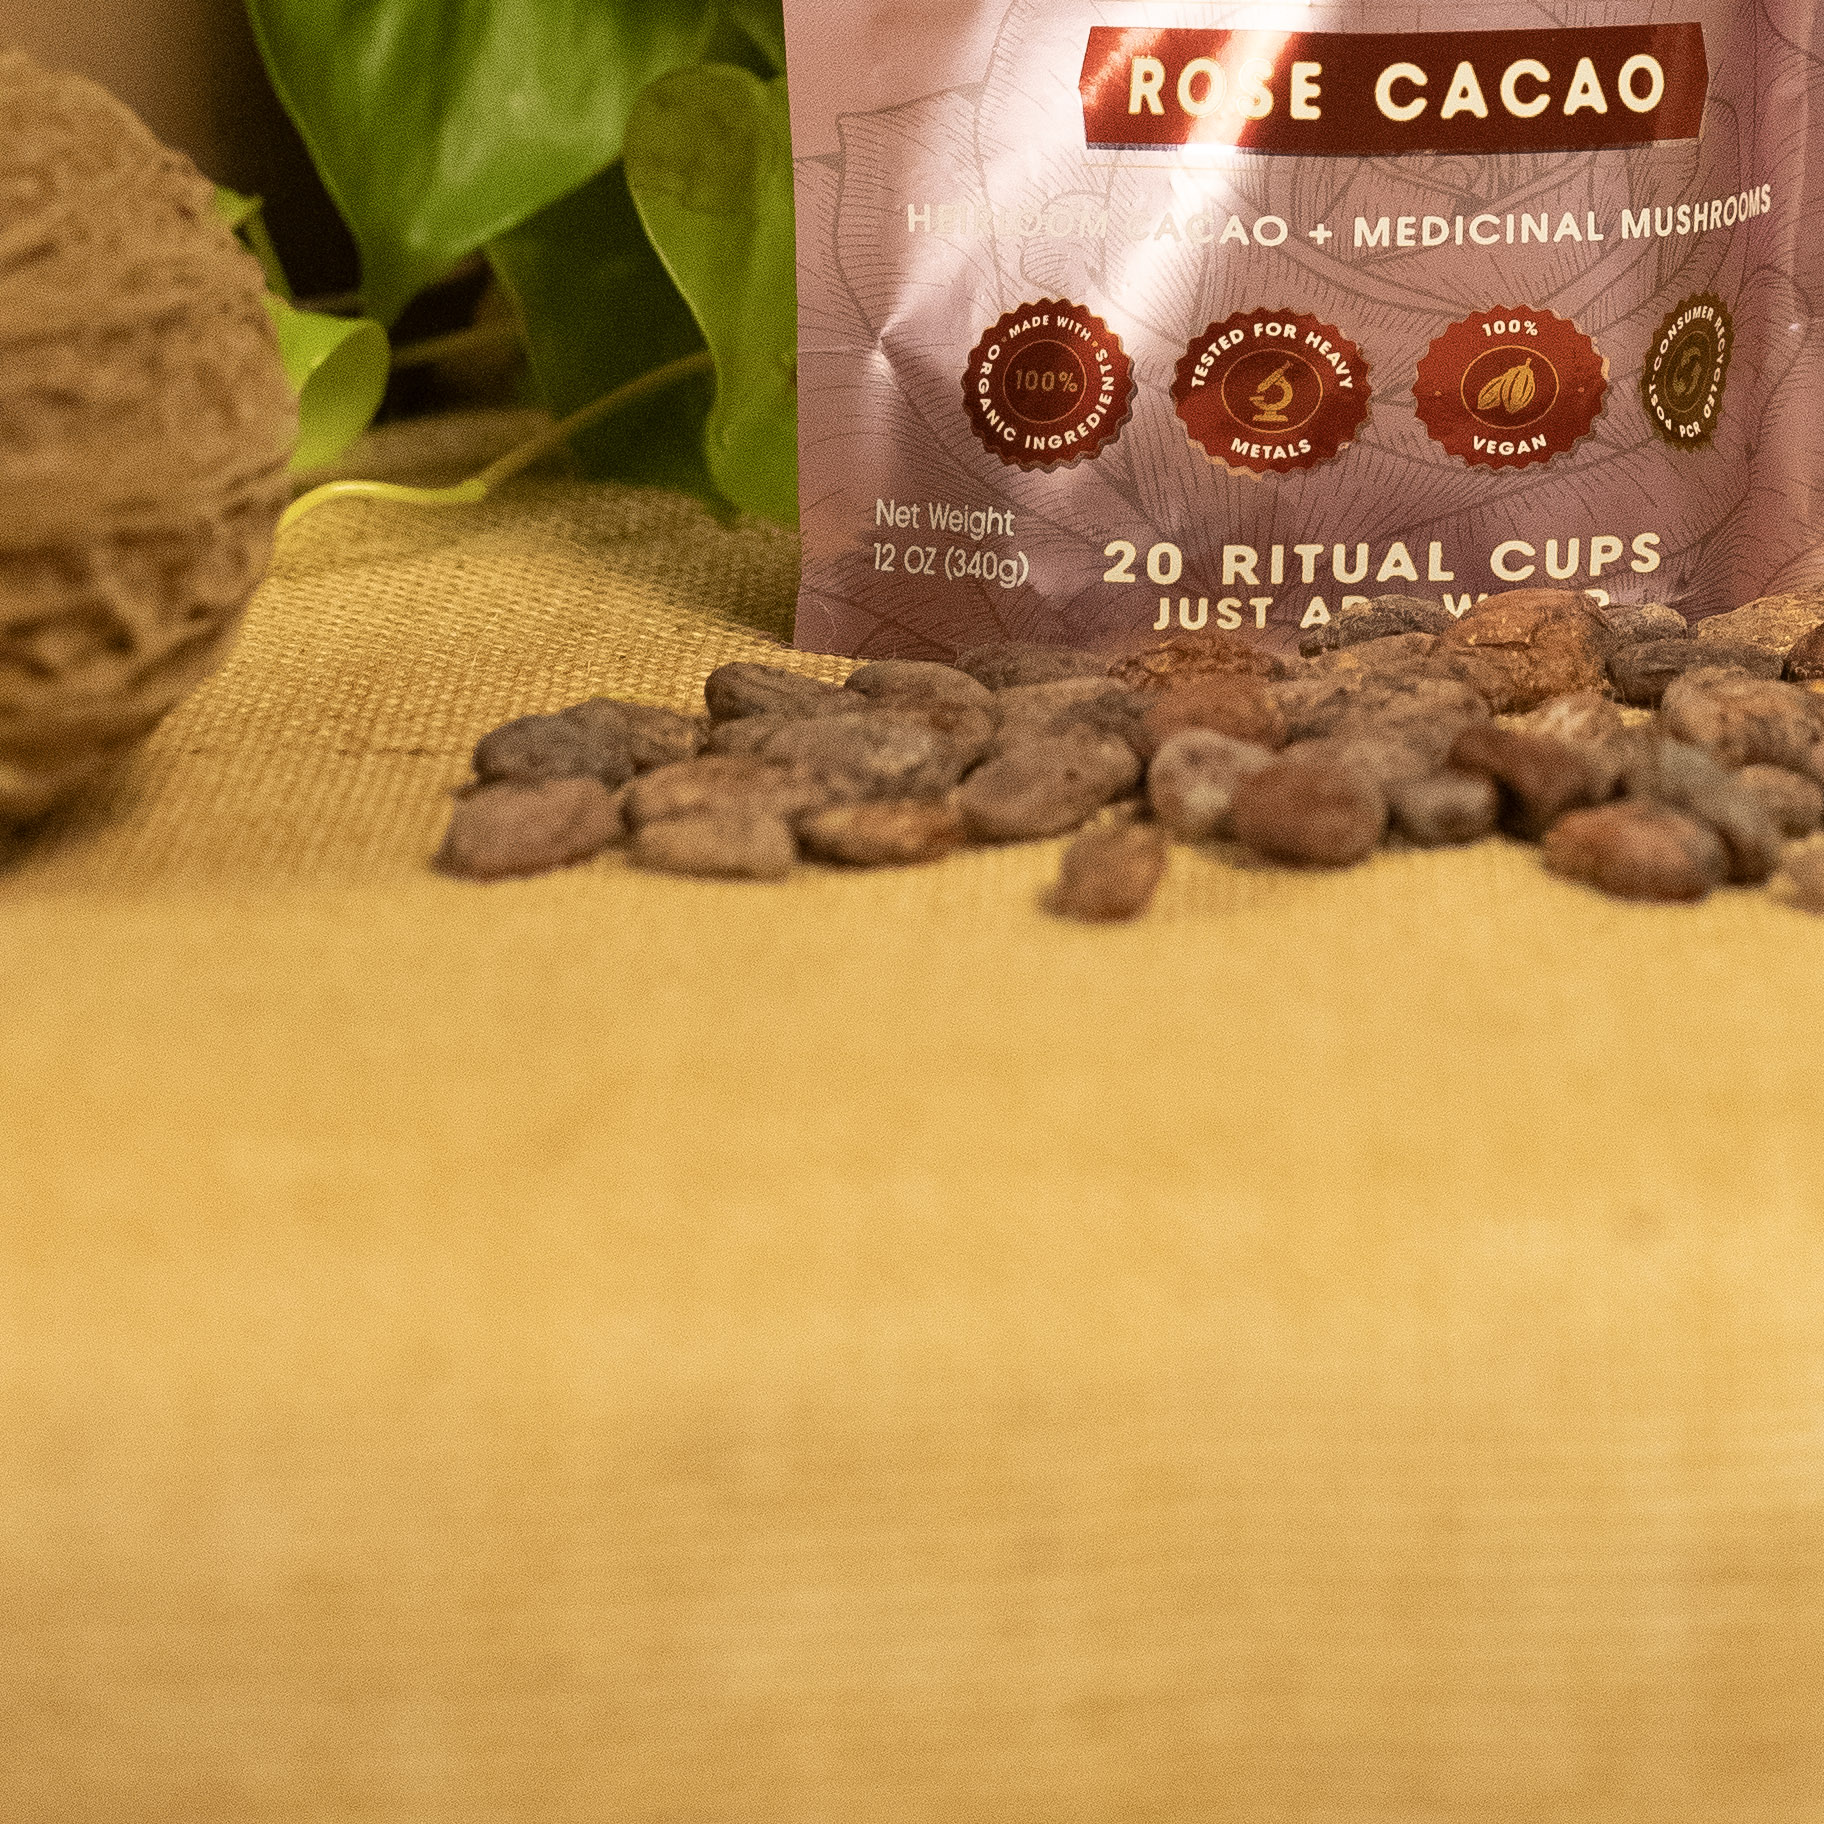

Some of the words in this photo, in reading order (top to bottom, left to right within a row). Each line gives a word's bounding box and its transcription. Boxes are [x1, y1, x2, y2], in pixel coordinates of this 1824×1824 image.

[1128, 56, 1323, 121] ROSE
[1375, 53, 1665, 121] CACAO
[1129, 212, 1289, 248] CACAO
[1308, 223, 1333, 245] +
[1353, 210, 1604, 248] MEDICINAL
[1621, 183, 1772, 240] MUSHROOMS
[1008, 314, 1050, 339] MADE
[1056, 315, 1092, 341] WITH
[1482, 319, 1539, 337] 100%
[1191, 328, 1245, 388] TESTED
[1253, 322, 1297, 339] FOR
[1304, 331, 1354, 389] HEAVY
[978, 344, 1017, 442] ORGANIC
[1024, 348, 1115, 450] INGREDIENTS
[1014, 369, 1079, 394] 100%
[1230, 438, 1312, 459] METALS
[1472, 433, 1548, 456] VEGAN
[1679, 421, 1702, 438] PCR
[875, 498, 921, 529] Net
[928, 502, 1016, 541] Weight
[873, 542, 897, 572] 12
[904, 545, 938, 574] OZ
[944, 545, 1030, 589] (340g)
[1103, 540, 1184, 585] 20
[1221, 541, 1455, 586] RITUAL
[1489, 532, 1661, 582] CUPS
[1153, 596, 1274, 631] JUST
